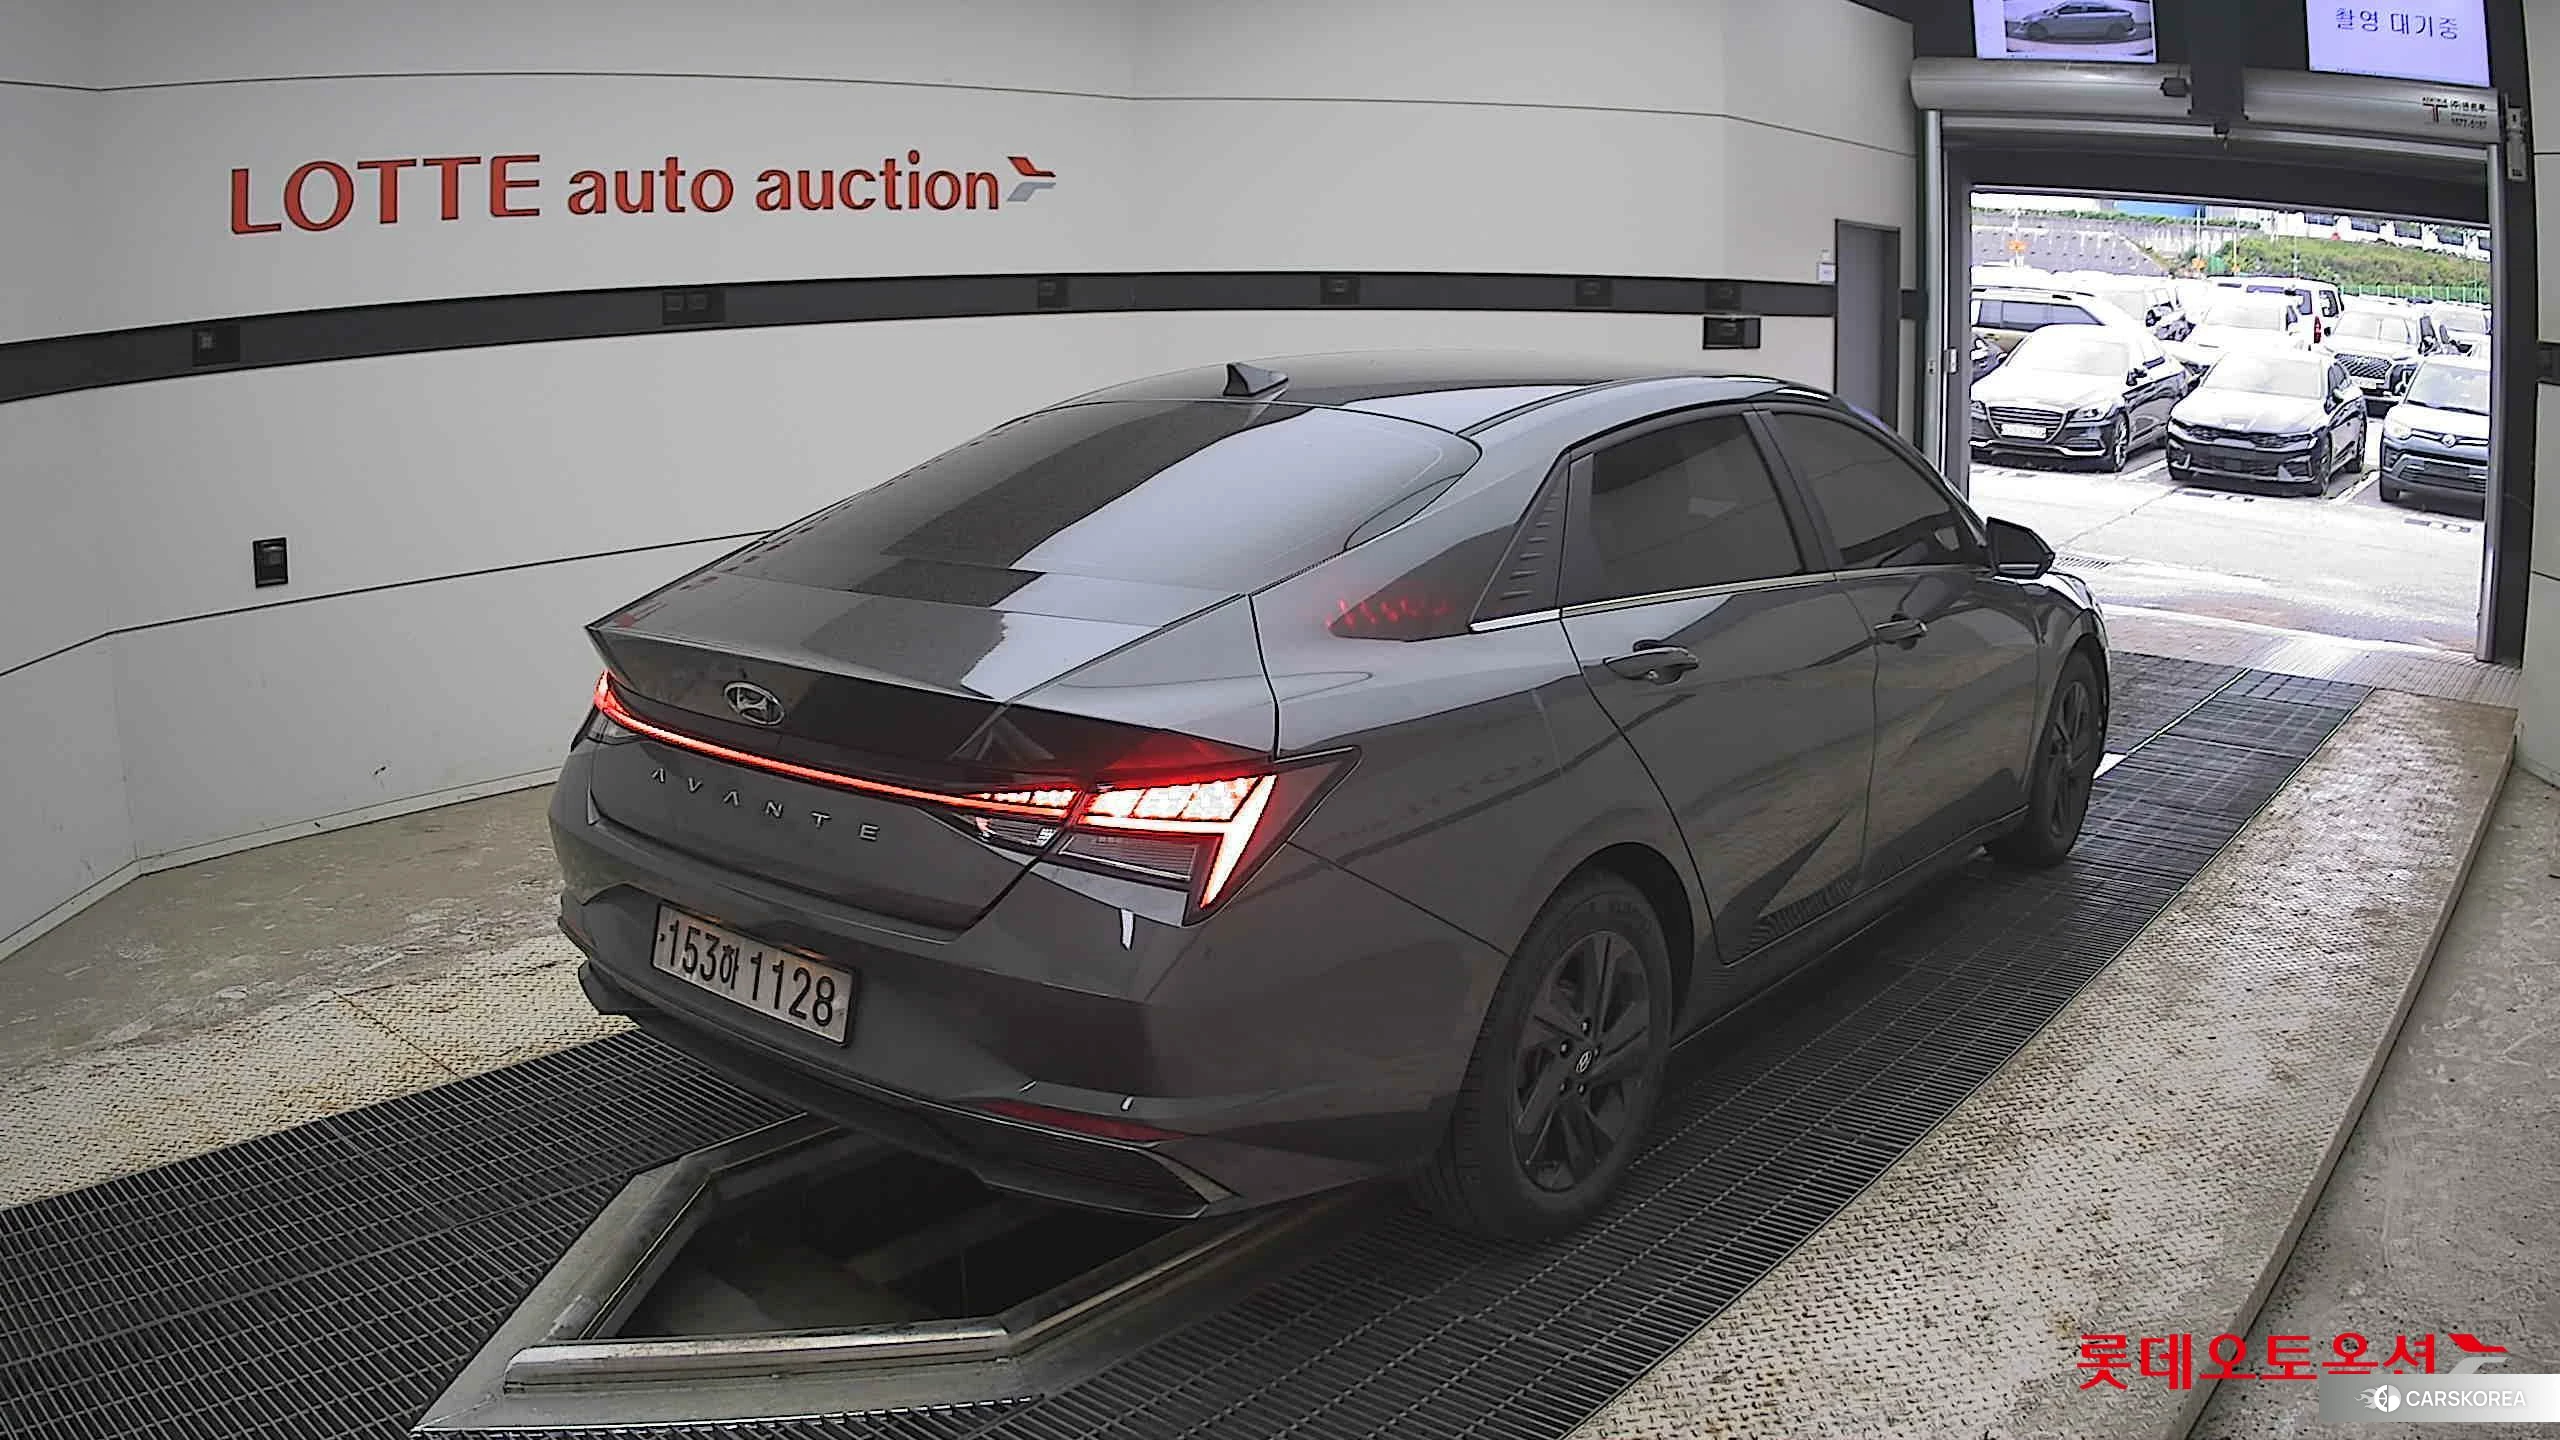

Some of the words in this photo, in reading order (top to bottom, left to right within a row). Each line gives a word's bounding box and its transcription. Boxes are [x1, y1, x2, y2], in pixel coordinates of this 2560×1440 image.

[2335, 8, 2379, 32] 촬영
[231, 154, 541, 234] LOTTE
[567, 156, 735, 215] auto
[755, 149, 1000, 211] auction
[651, 767, 880, 841] AVANTE
